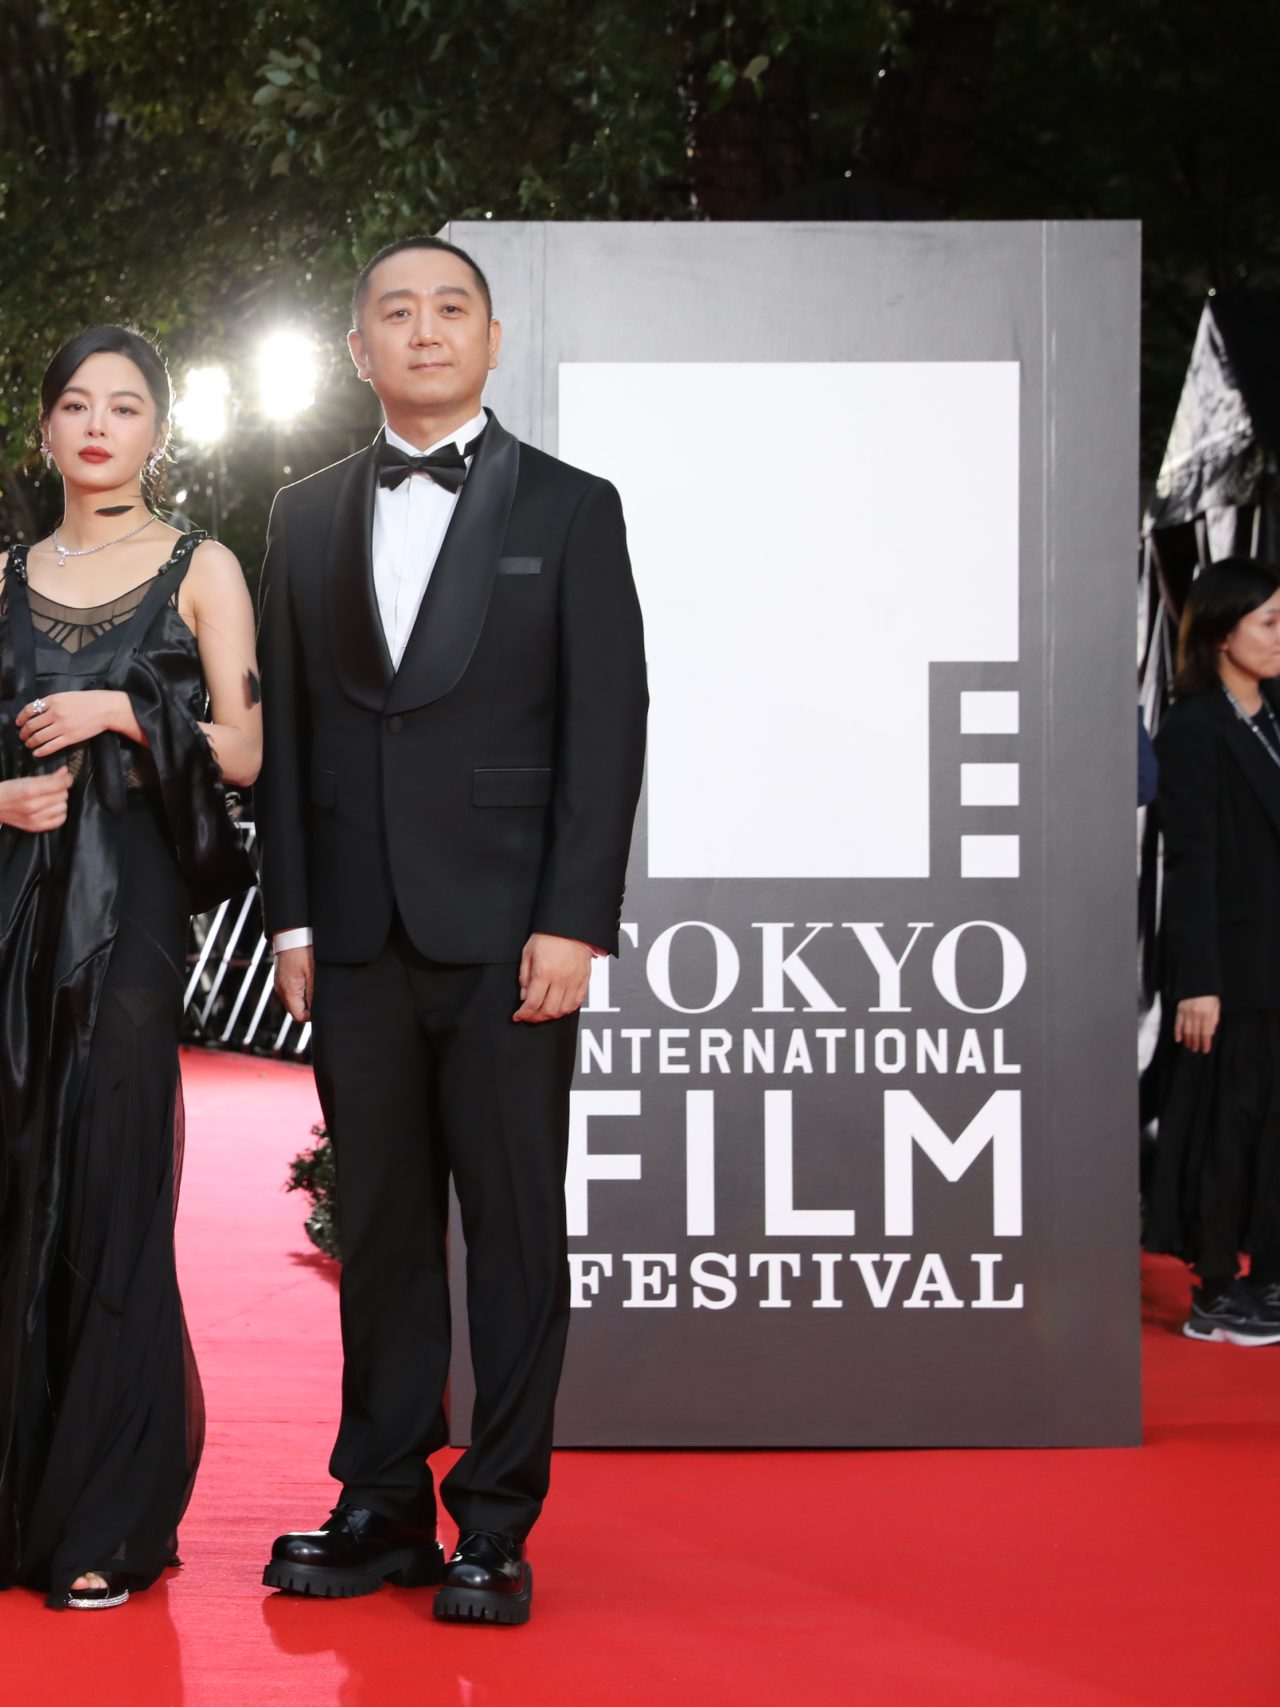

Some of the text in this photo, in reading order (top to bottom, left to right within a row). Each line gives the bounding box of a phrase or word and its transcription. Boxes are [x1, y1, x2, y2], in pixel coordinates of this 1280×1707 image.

[580, 1028, 1022, 1074] NTERNATIONAL
[564, 1089, 1023, 1237] FILM
[567, 1252, 1024, 1310] FESTIVAL
